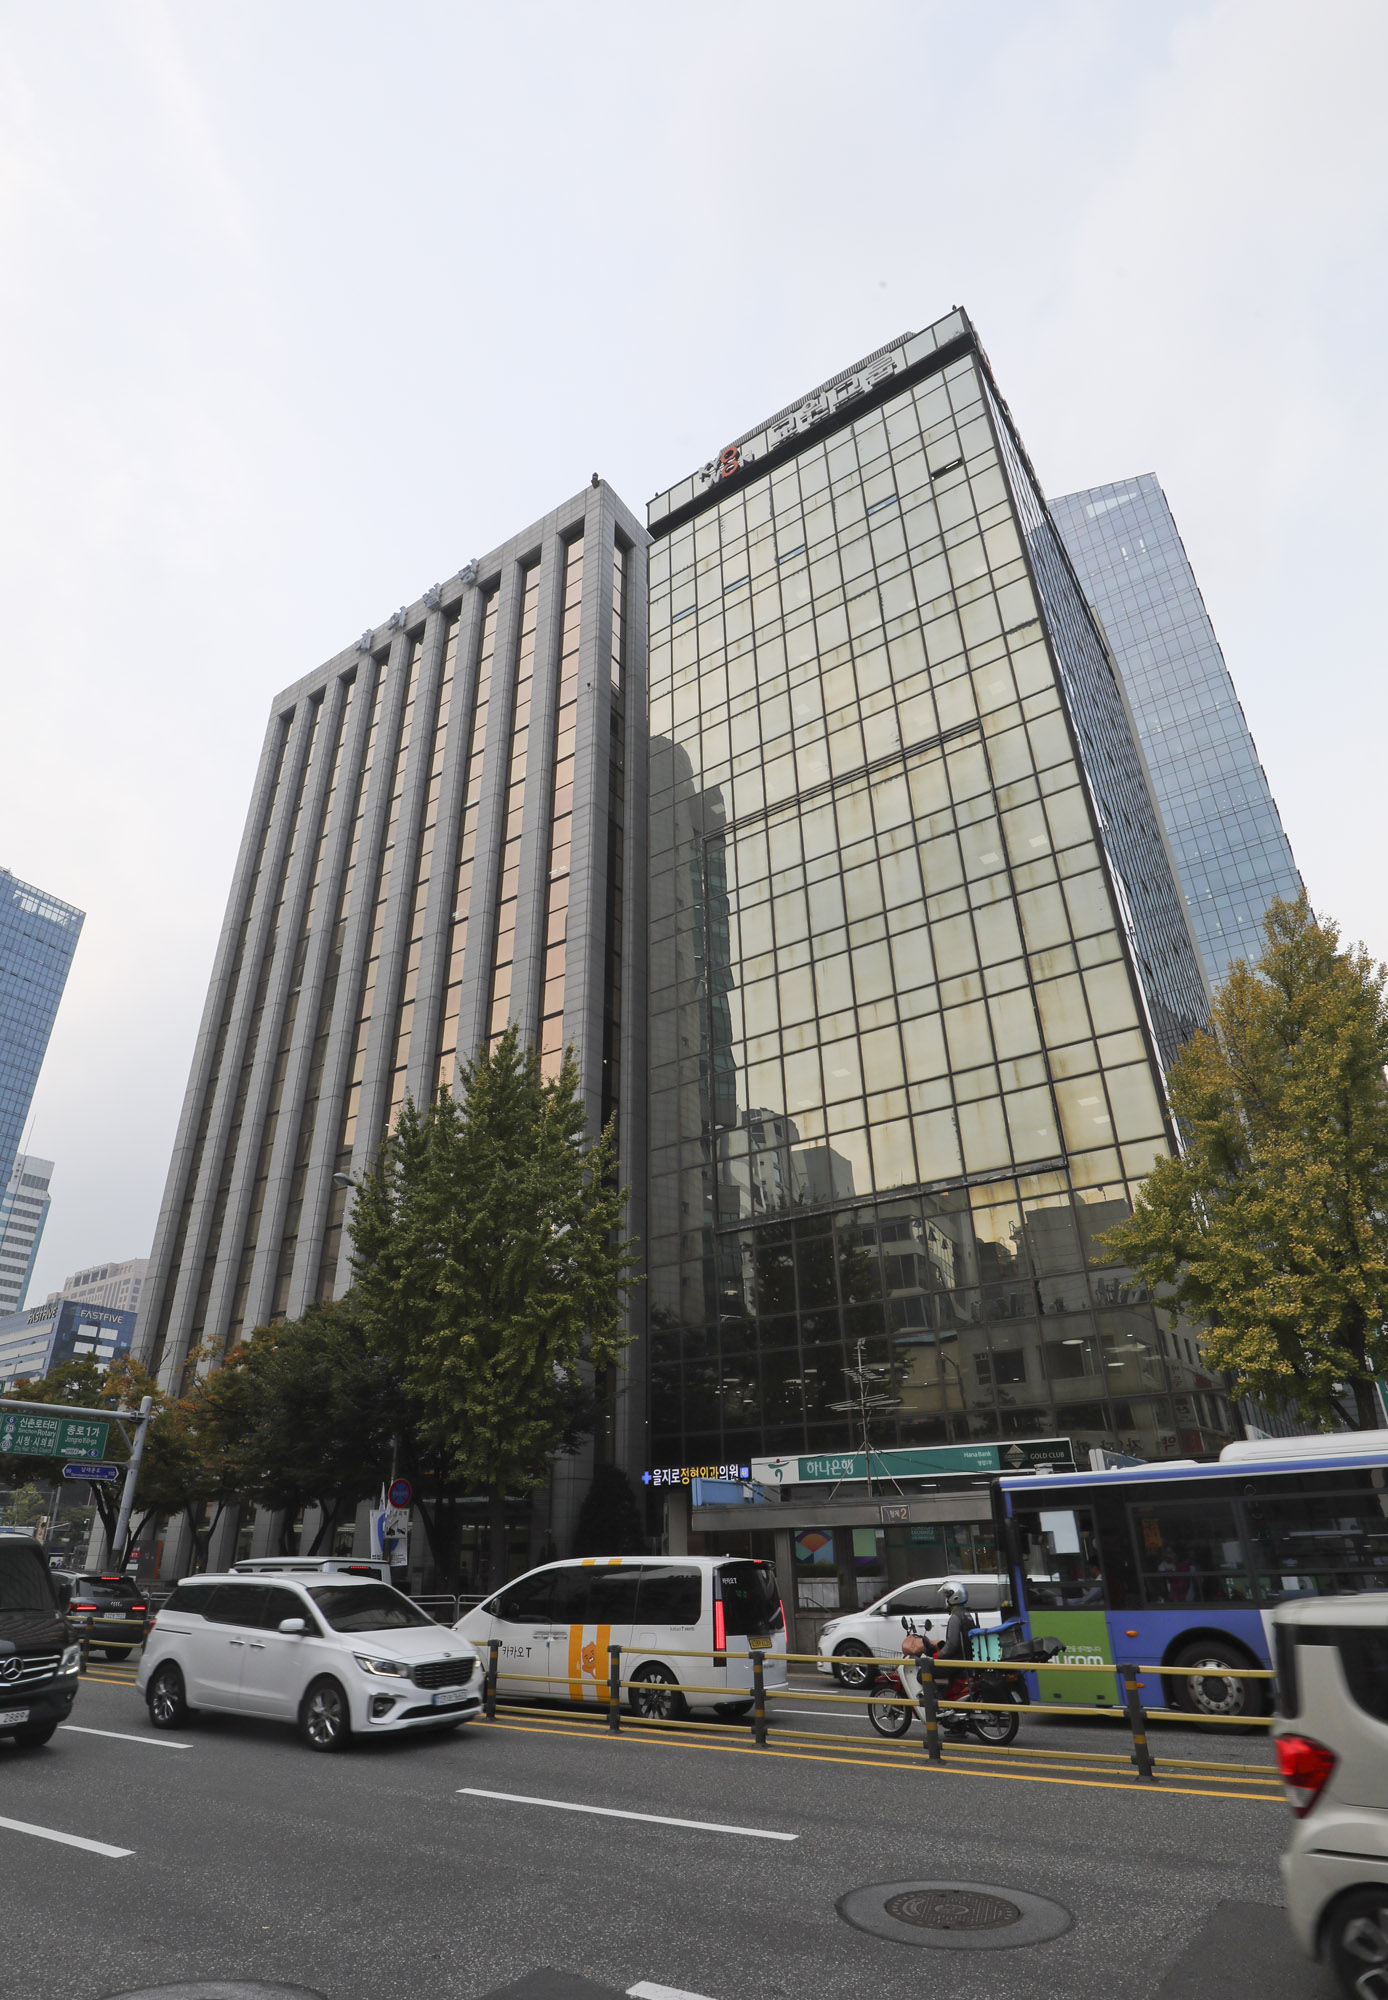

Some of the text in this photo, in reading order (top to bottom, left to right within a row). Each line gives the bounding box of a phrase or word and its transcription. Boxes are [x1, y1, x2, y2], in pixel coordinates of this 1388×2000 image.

[27, 1307, 58, 1324] FASTFIVE
[80, 1309, 124, 1324] FASTFIVE
[20, 1417, 58, 1430] 신촌로터리
[37, 1429, 56, 1438] Rotary
[806, 1457, 854, 1477] 하나은행
[502, 1646, 532, 1659] 카카오 T
